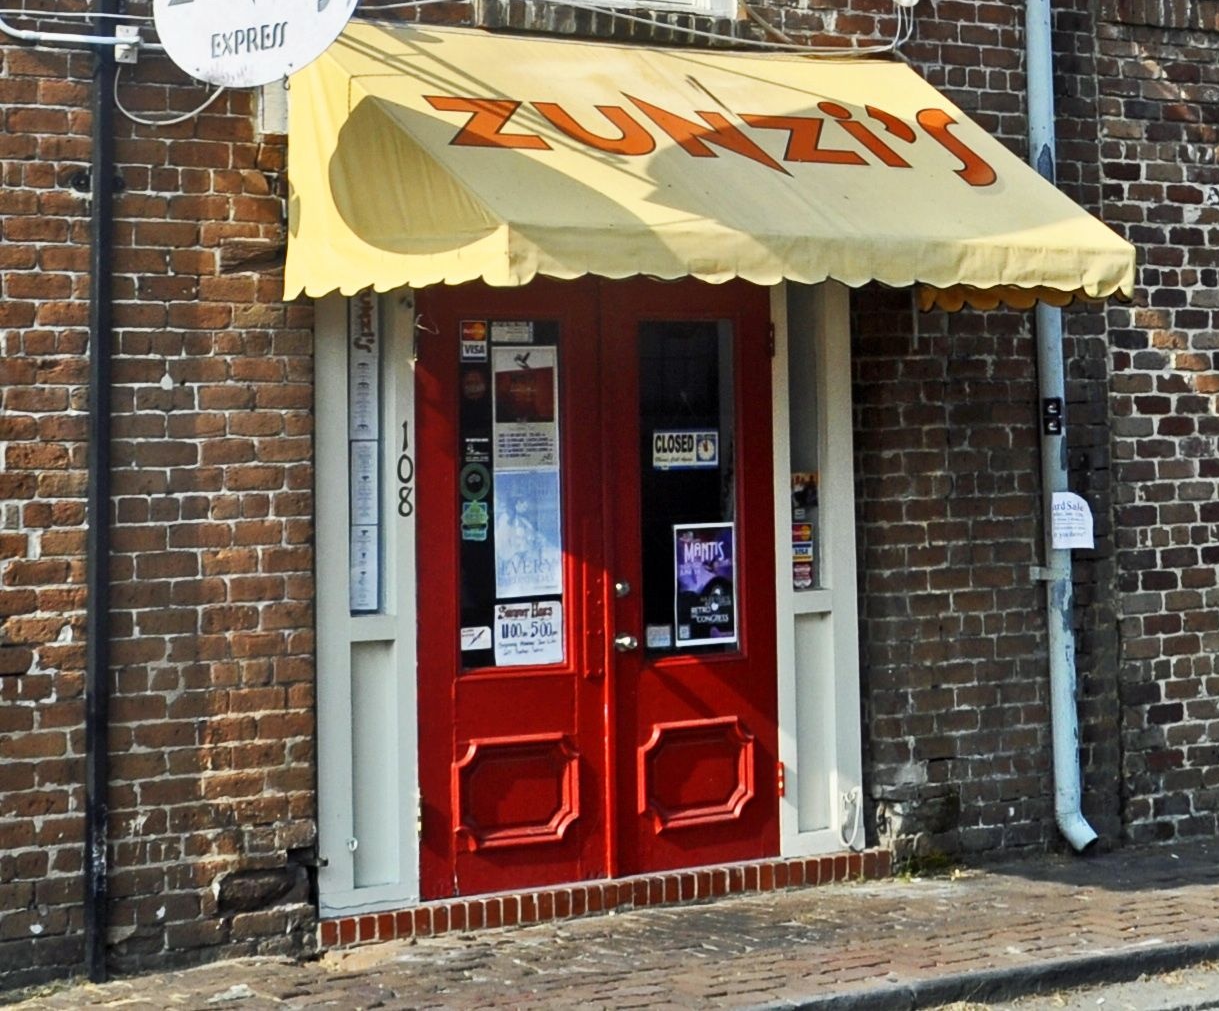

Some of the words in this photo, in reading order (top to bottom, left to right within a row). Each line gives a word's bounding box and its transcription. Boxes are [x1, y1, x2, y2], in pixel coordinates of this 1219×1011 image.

[210, 21, 289, 59] EXPRESS
[464, 344, 485, 354] VISA
[655, 434, 694, 454] CLOSED
[396, 419, 414, 518] 108
[684, 541, 725, 563] MANTIS
